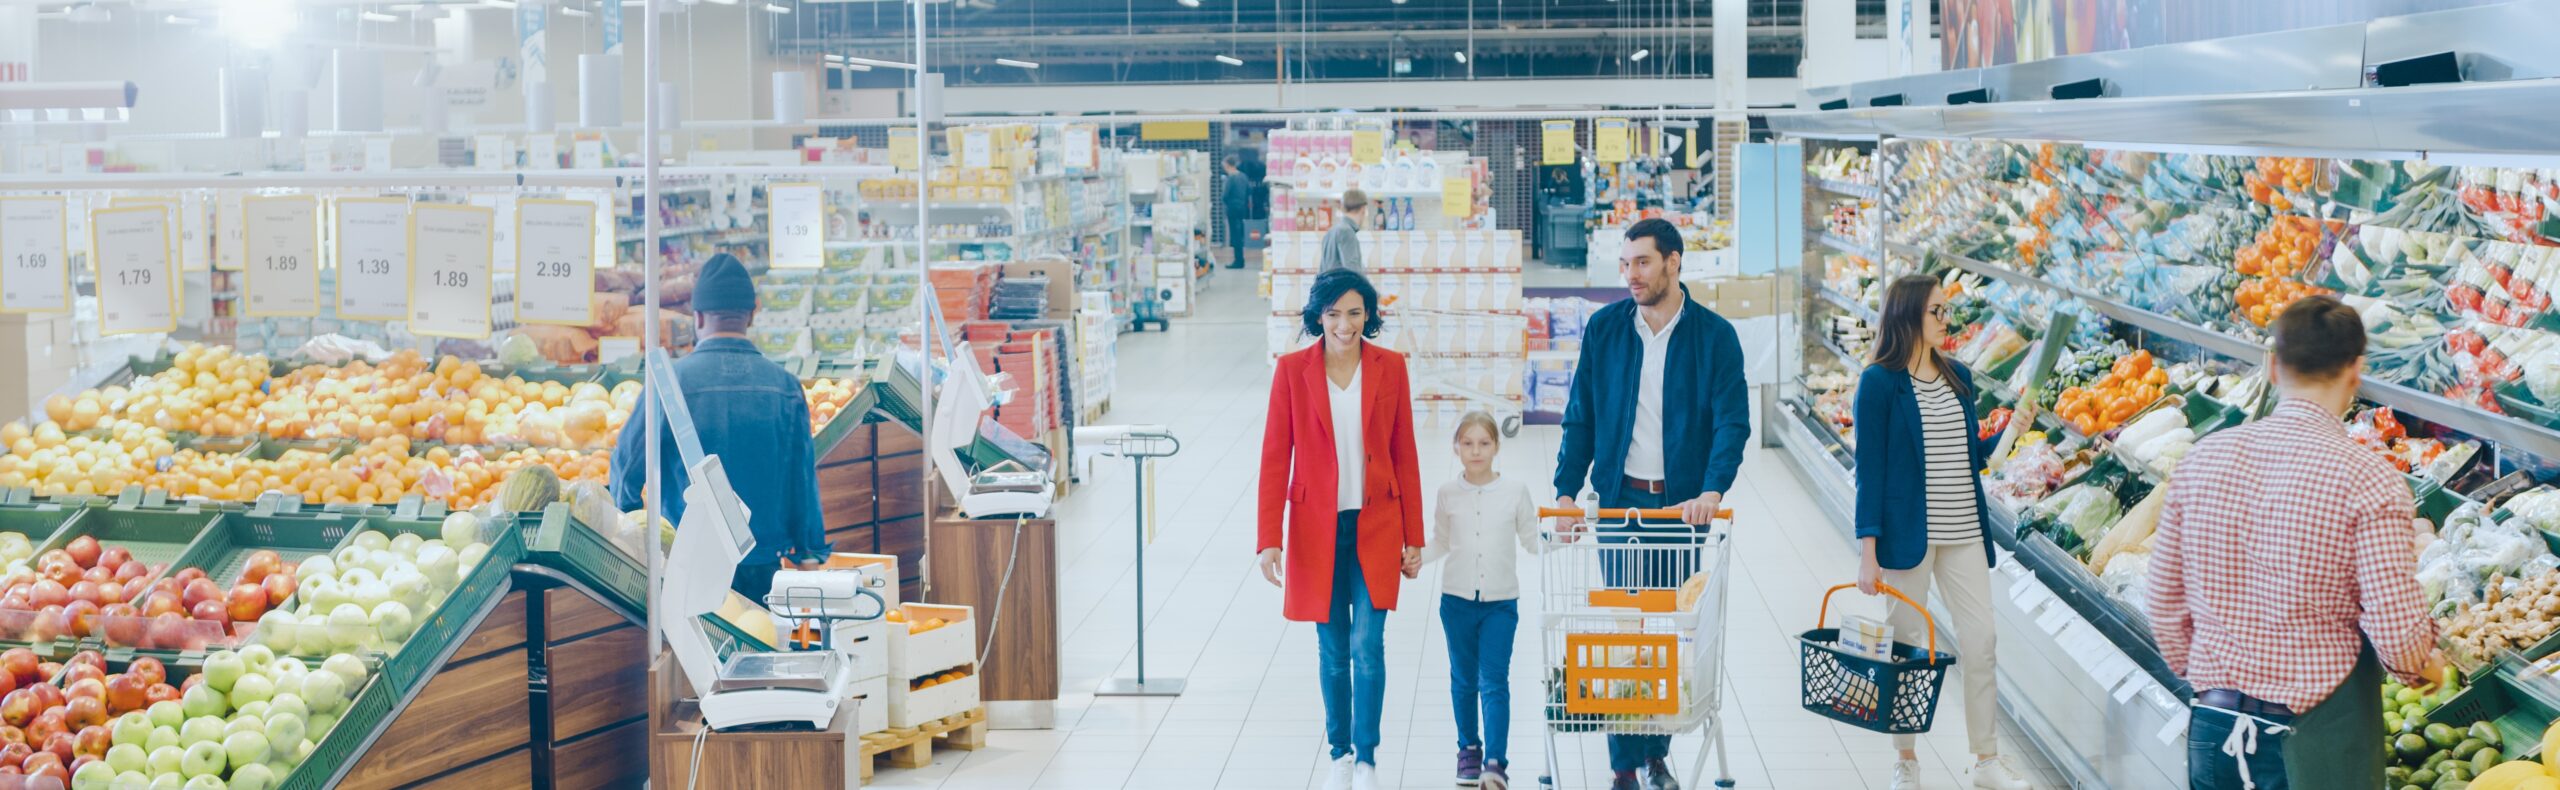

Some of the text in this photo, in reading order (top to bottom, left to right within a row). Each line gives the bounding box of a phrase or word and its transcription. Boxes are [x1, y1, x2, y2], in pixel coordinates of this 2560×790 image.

[784, 224, 809, 236] 1.39
[17, 253, 47, 269] 1.69
[265, 255, 298, 271] 1.89
[357, 258, 390, 275] 1.39
[536, 261, 572, 278] 2.99
[118, 268, 152, 286] 1.79
[433, 269, 469, 288] 1.89
